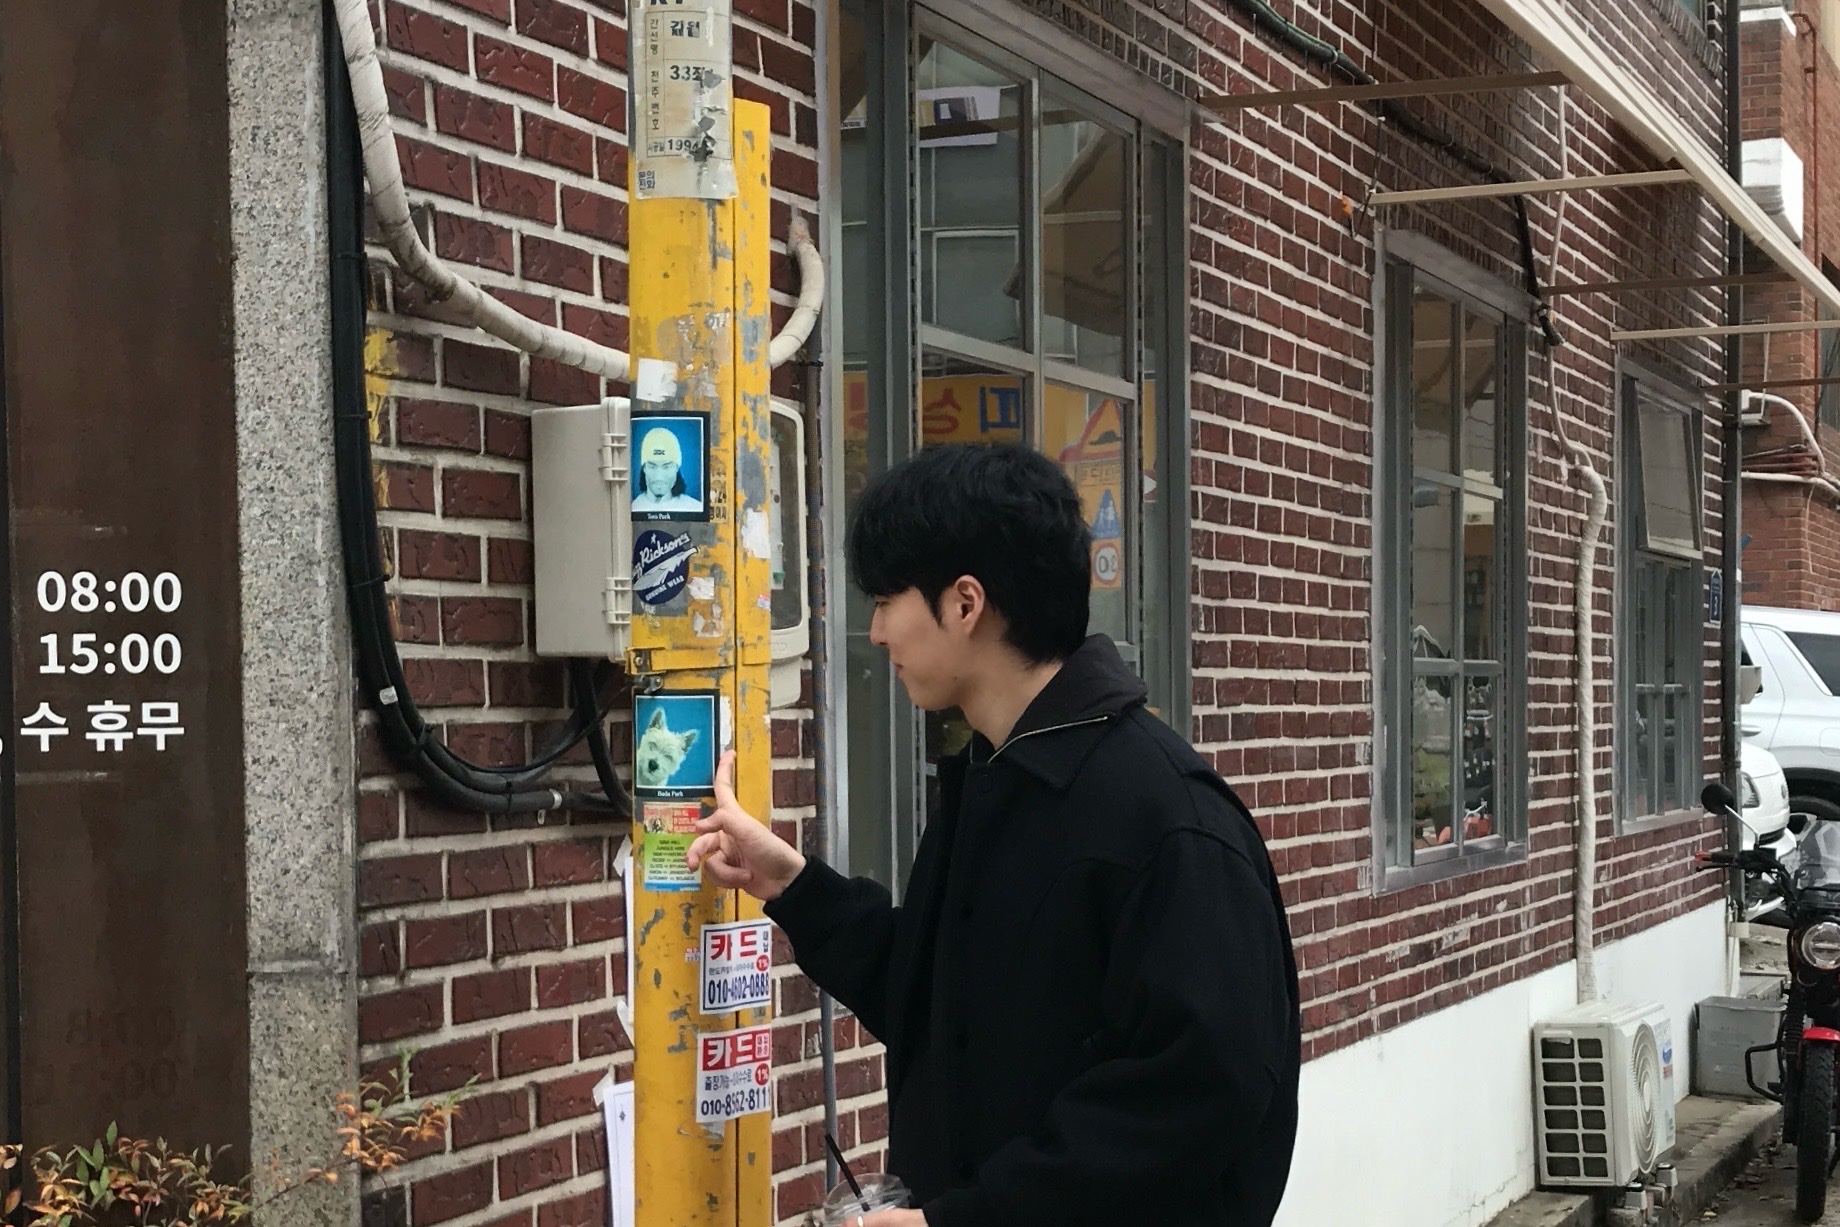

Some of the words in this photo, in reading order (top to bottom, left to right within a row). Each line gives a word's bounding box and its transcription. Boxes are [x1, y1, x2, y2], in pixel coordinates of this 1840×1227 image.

[37, 571, 182, 612] 08:00
[39, 632, 182, 674] 15:00
[20, 702, 69, 752] 수
[85, 700, 185, 752] 휴무
[711, 930, 757, 961] 카드
[707, 1034, 753, 1067] 카드
